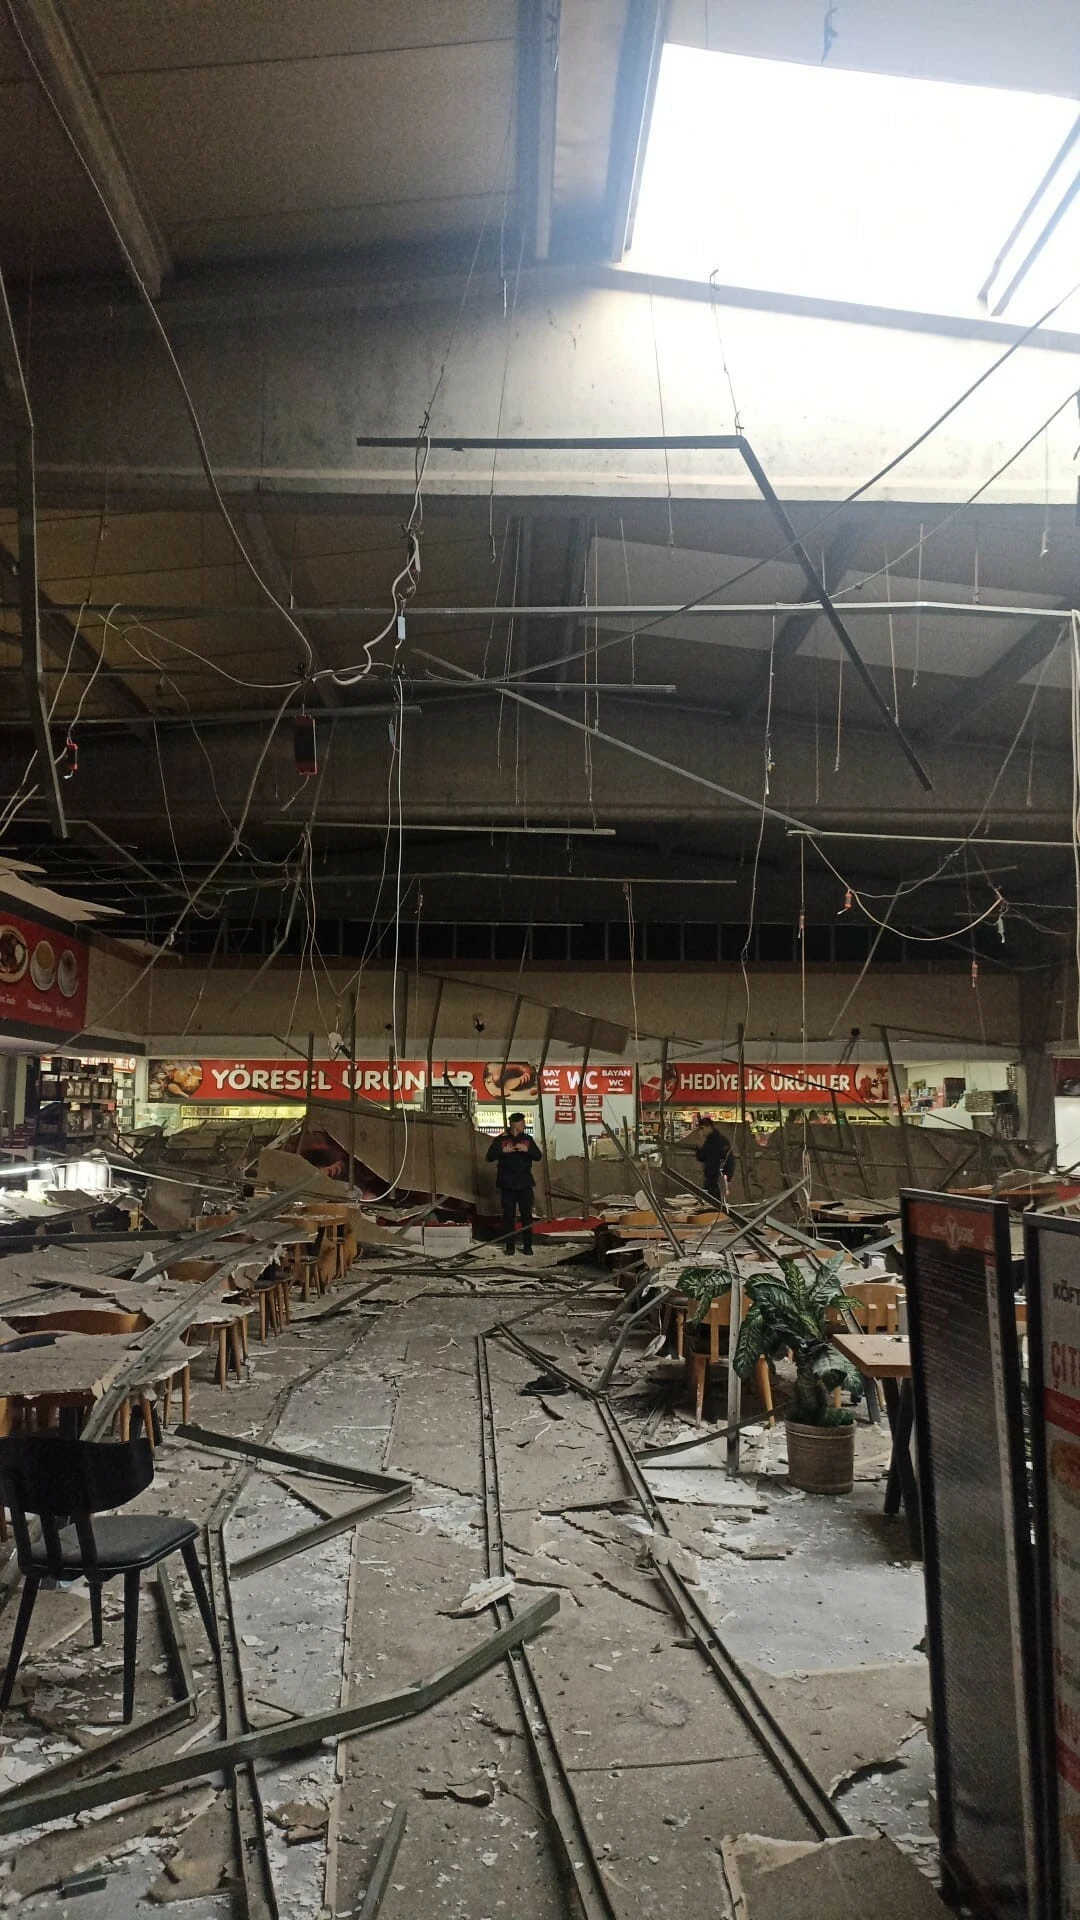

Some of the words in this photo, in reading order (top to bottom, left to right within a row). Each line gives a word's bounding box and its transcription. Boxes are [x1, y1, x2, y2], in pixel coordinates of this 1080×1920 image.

[211, 1064, 331, 1091] YÖRESEL
[567, 1070, 598, 1090] WC
[602, 1069, 630, 1077] BAYAN
[680, 1069, 765, 1091] HEDİYEİK
[770, 1069, 850, 1091] ÜRÜNLER
